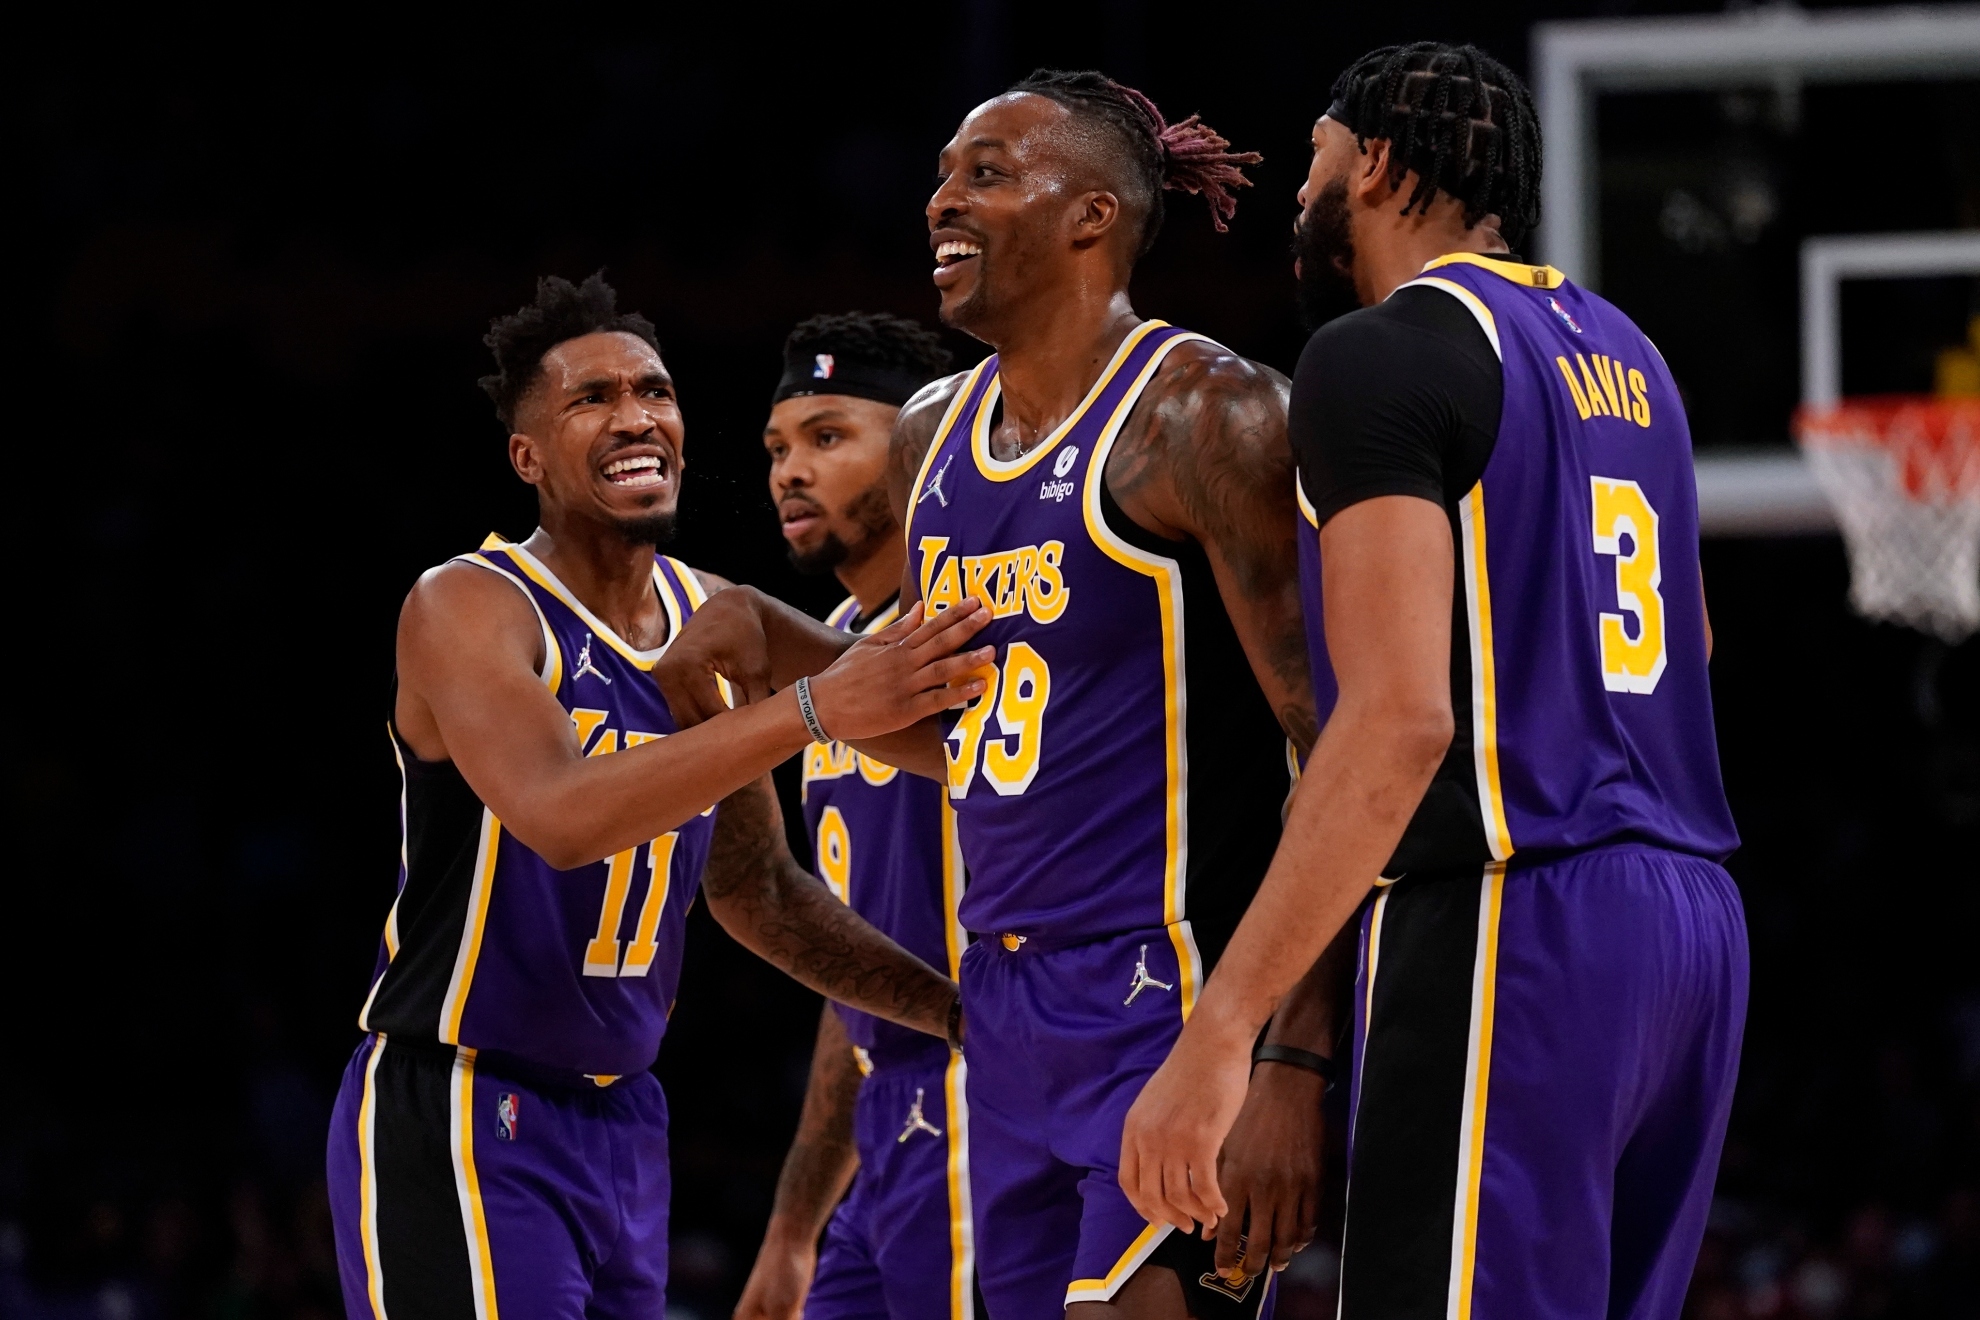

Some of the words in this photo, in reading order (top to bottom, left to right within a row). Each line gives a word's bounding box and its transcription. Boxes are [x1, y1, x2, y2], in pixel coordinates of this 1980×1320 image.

[1556, 353, 1651, 428] DAVIS
[1039, 480, 1075, 503] bibigo
[917, 535, 1071, 625] LAKERS
[1590, 475, 1668, 695] 3
[802, 700, 816, 727] YOUR
[943, 641, 1051, 800] 39
[582, 831, 680, 978] 11
[817, 805, 851, 908] 9
